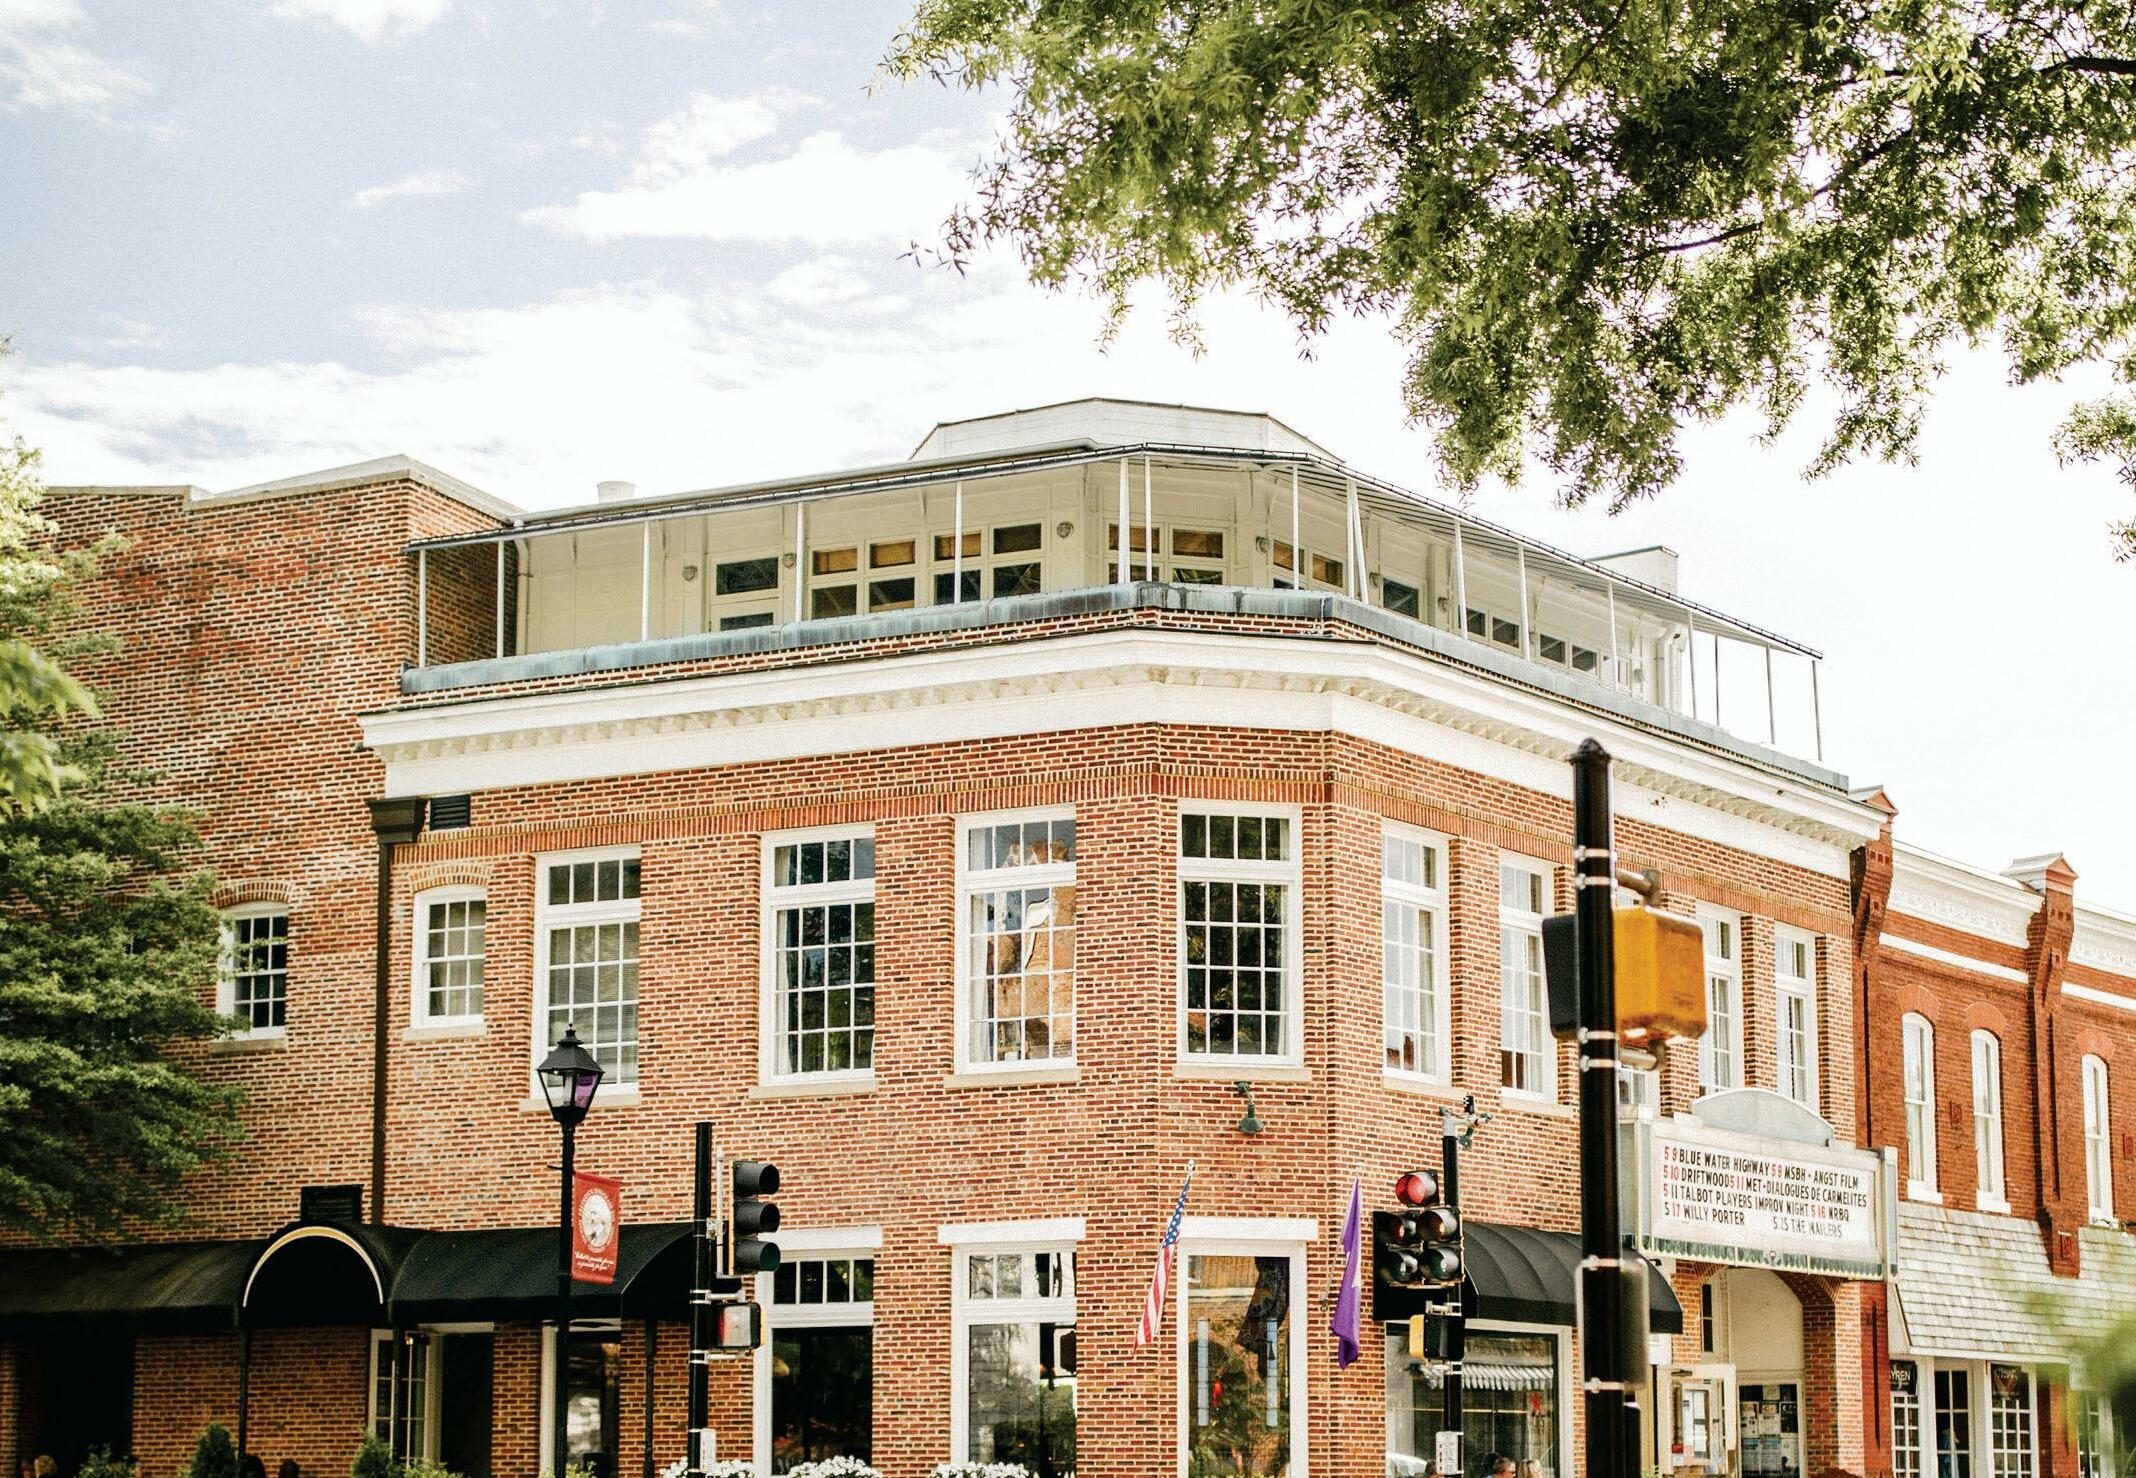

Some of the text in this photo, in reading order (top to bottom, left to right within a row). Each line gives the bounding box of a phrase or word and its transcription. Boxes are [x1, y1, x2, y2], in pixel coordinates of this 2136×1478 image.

[1679, 1149, 1701, 1166] BLUE
[1704, 1152, 1730, 1169] WATER
[1733, 1158, 1770, 1176] HIGHWAY
[1813, 1170, 1838, 1187] ANGST
[1840, 1174, 1859, 1190] FILM
[1681, 1167, 1730, 1188] DRIFTWOOD
[1811, 1187, 1821, 1202] DE
[1822, 1188, 1867, 1208] CARMELITES
[1680, 1185, 1713, 1204] TALBOT
[1716, 1191, 1752, 1209] PLAYERS
[1755, 1196, 1784, 1214] IMPROV
[1786, 1201, 1809, 1217] NIGHT
[1828, 1206, 1849, 1222] NRBQ
[1683, 1204, 1709, 1221] WILLY
[1712, 1208, 1745, 1226] PORTER
[1791, 1218, 1806, 1234] THE
